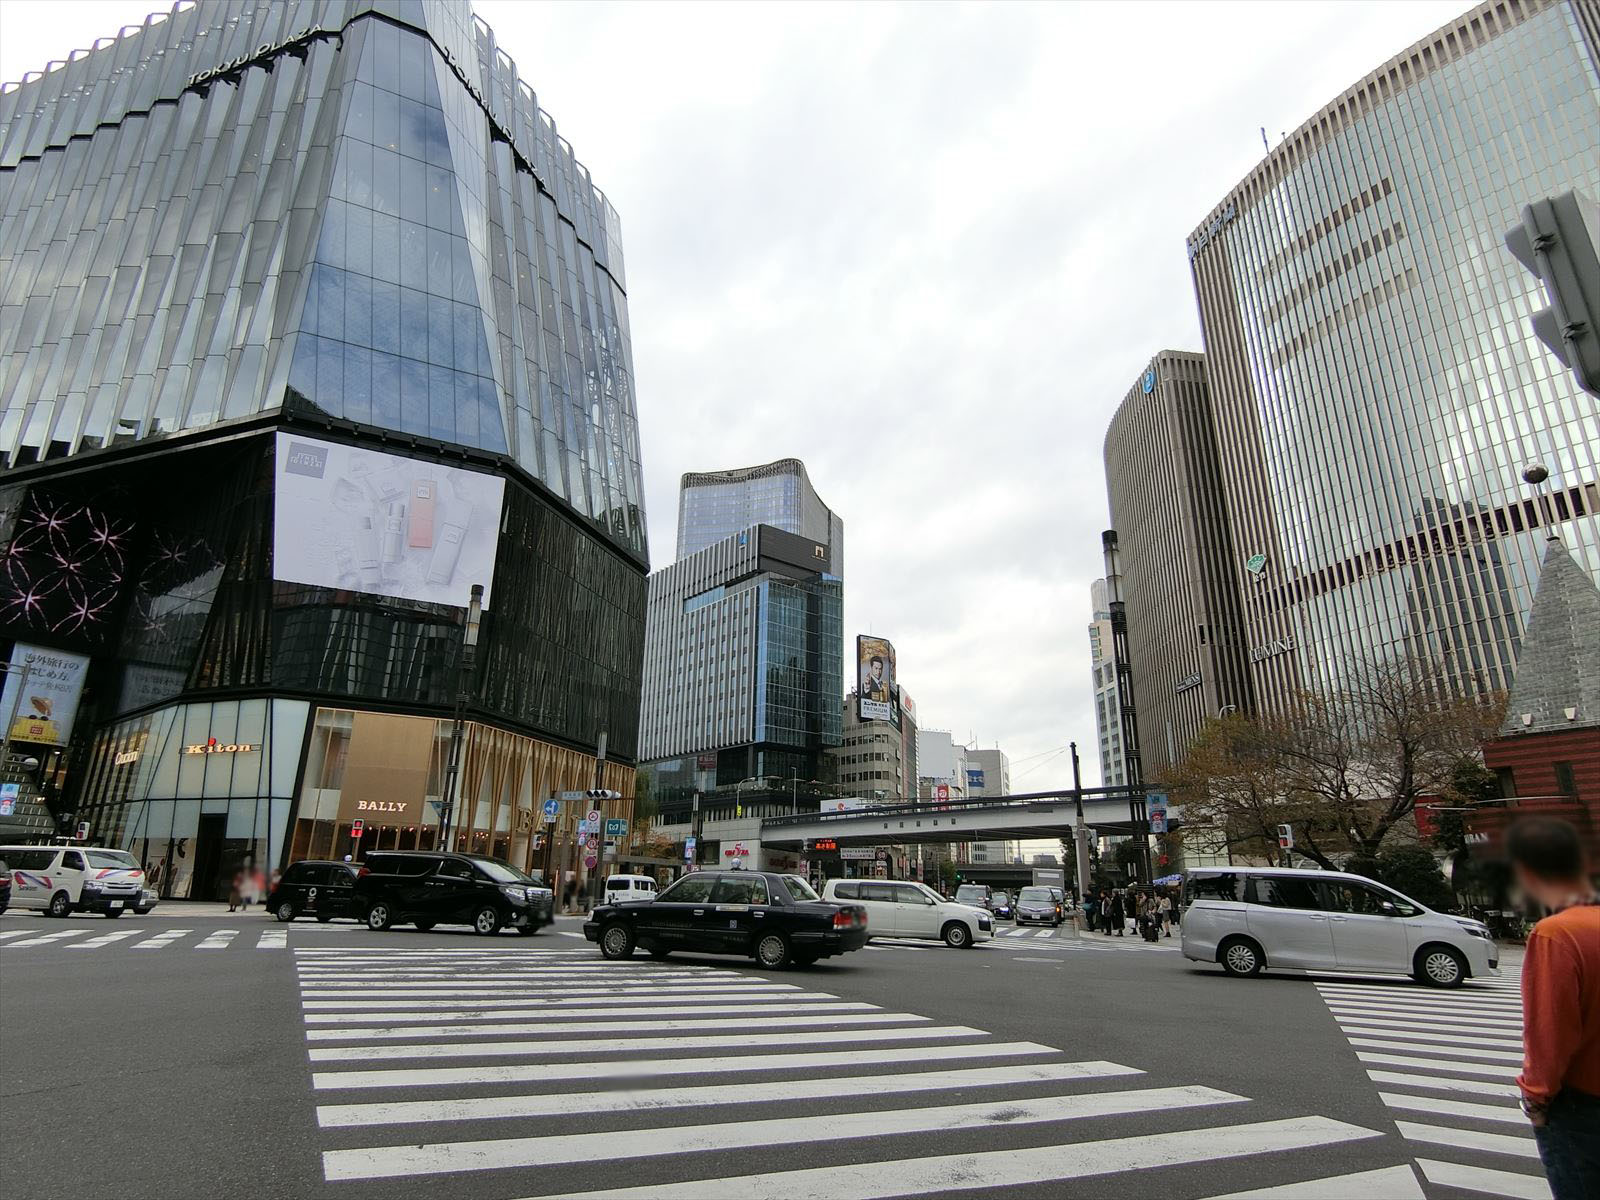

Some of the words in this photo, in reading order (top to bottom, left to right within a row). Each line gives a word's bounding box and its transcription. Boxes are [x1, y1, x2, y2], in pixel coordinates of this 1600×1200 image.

[188, 53, 250, 85] TOKYU
[255, 23, 323, 57] PLAZA
[1249, 635, 1296, 663] LUMINE
[24, 652, 80, 671] 海外旅行の
[187, 740, 252, 754] Kiton
[357, 800, 408, 812] BALLY
